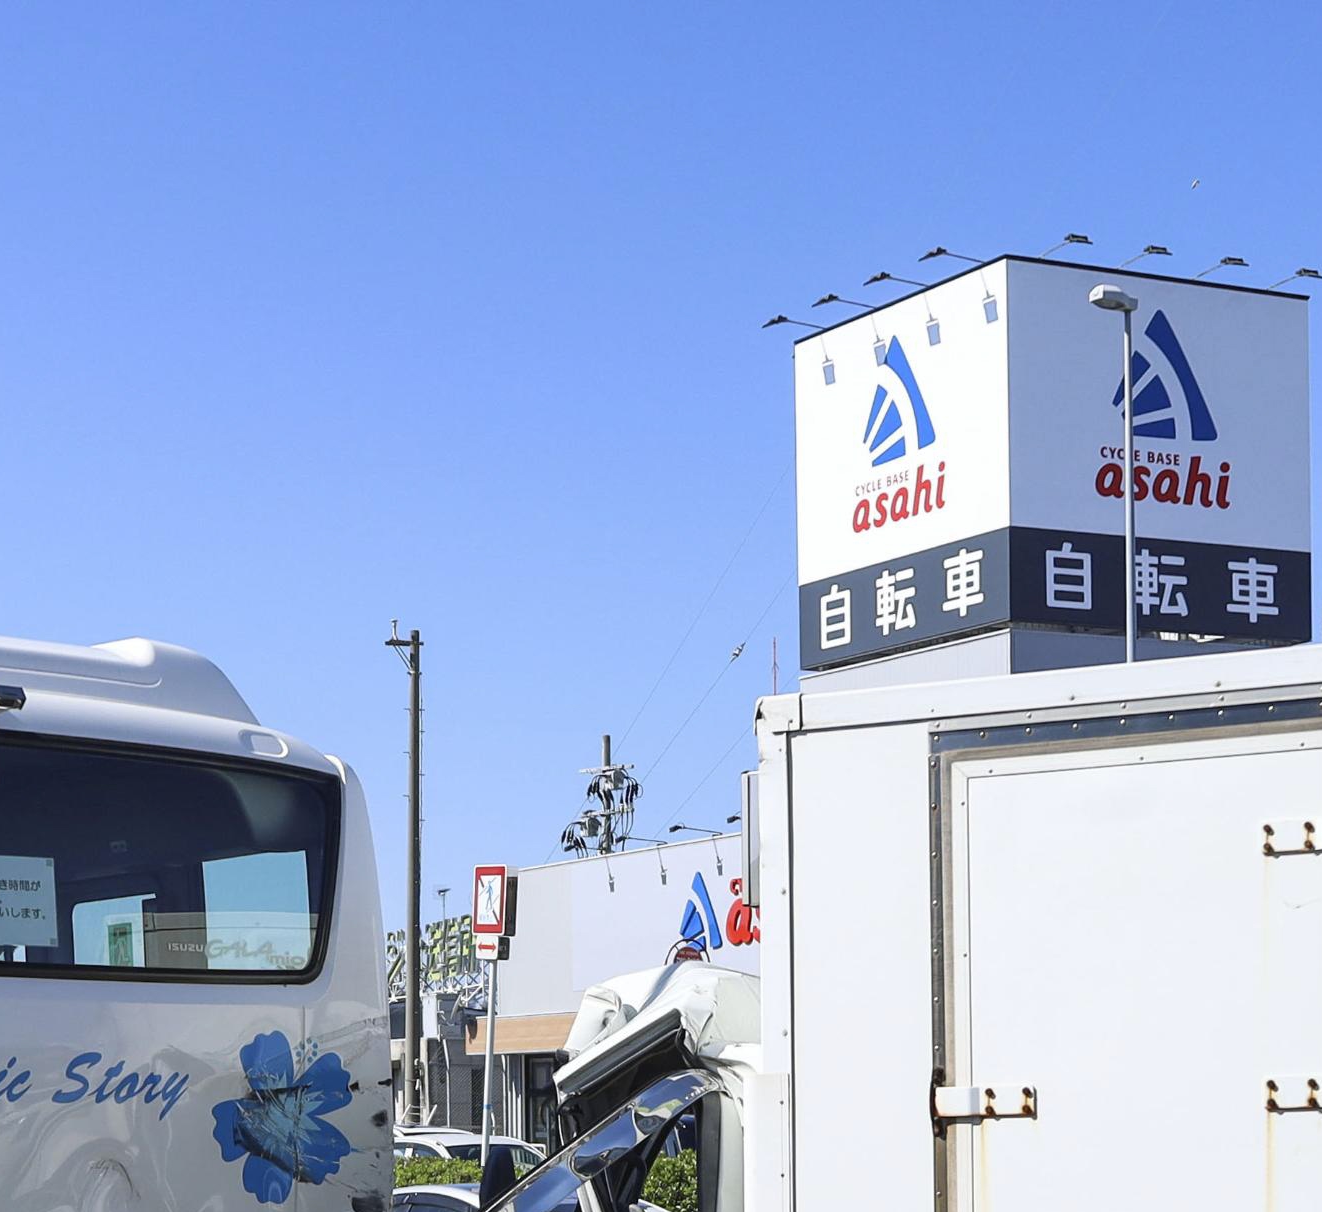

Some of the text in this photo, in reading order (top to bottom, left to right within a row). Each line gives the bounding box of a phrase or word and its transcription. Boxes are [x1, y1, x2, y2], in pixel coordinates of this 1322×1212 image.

[855, 470, 909, 496] CYCLE BASE
[1095, 456, 1230, 510] asahi
[1100, 447, 1180, 466] CYCE BASE
[852, 461, 945, 534] asahi
[819, 548, 984, 650] 自転車
[1045, 542, 1279, 623] 自転車
[167, 942, 204, 953] ISUZU
[204, 938, 273, 960] GALA
[53, 1051, 190, 1119] Story
